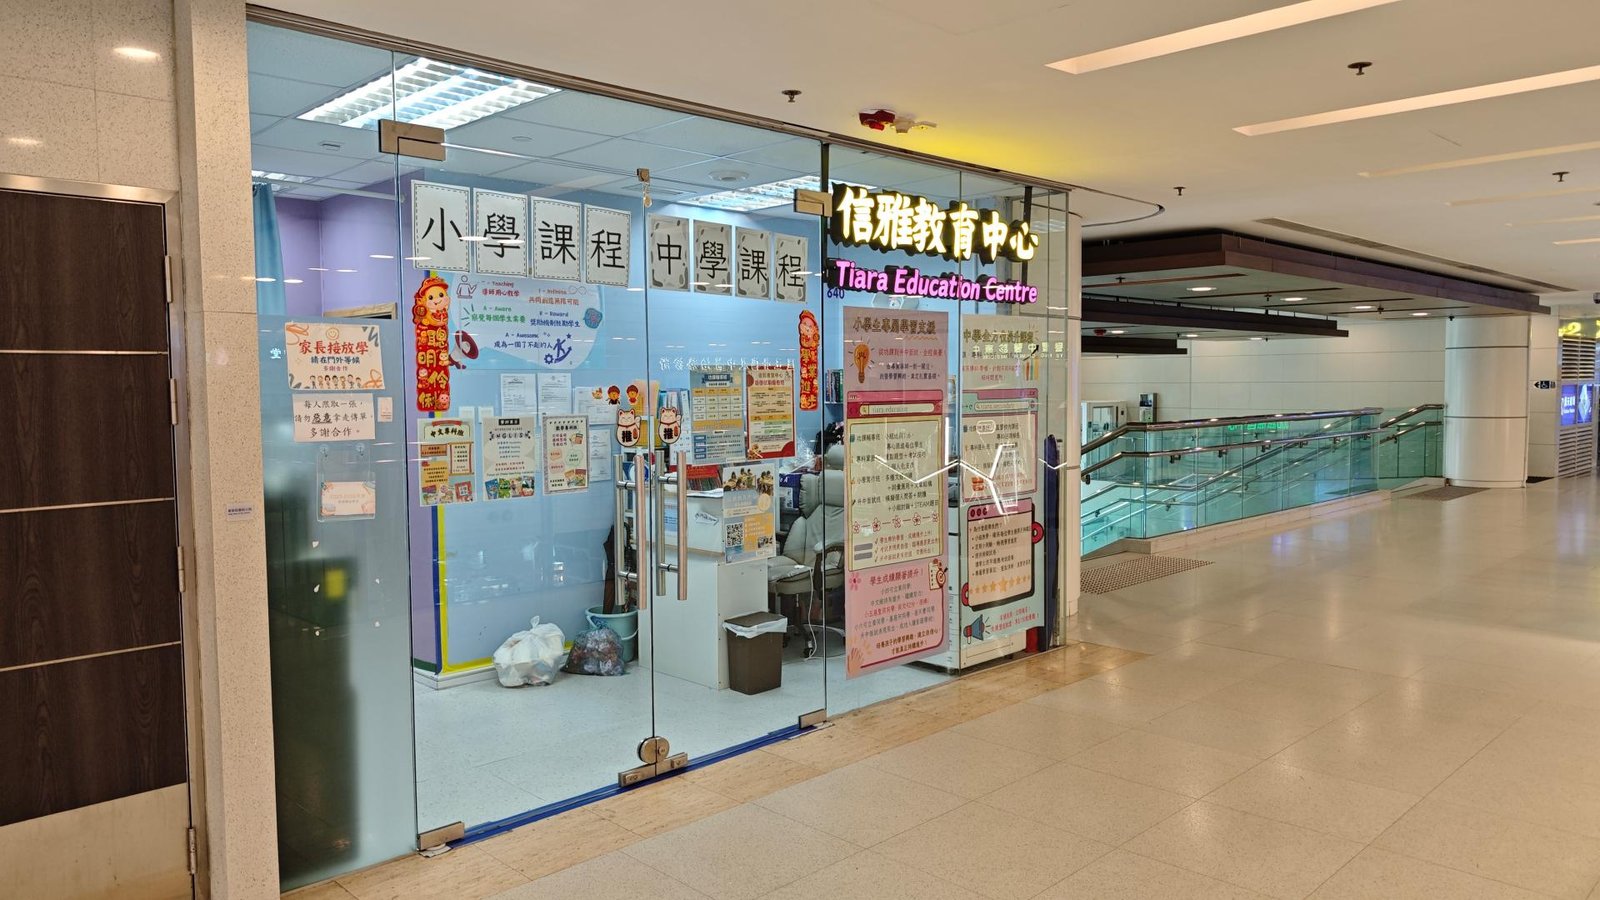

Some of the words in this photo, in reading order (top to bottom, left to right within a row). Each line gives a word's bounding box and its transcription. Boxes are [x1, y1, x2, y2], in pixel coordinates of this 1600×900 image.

[837, 187, 1039, 260] 信雅教育中心
[422, 207, 626, 270] 小學課程
[656, 234, 804, 288] 中學課程
[827, 288, 845, 299] 640
[836, 260, 888, 292] Tiara
[894, 269, 980, 300] Education
[985, 277, 1038, 303] Centre
[299, 340, 369, 355] 家長接放學
[311, 356, 361, 364] 請在門外等候
[417, 327, 447, 410] 聰明伶俐
[800, 348, 819, 409] 學業進步
[490, 432, 530, 440] ENGLISH
[621, 428, 633, 442] 推
[663, 427, 674, 440] 推
